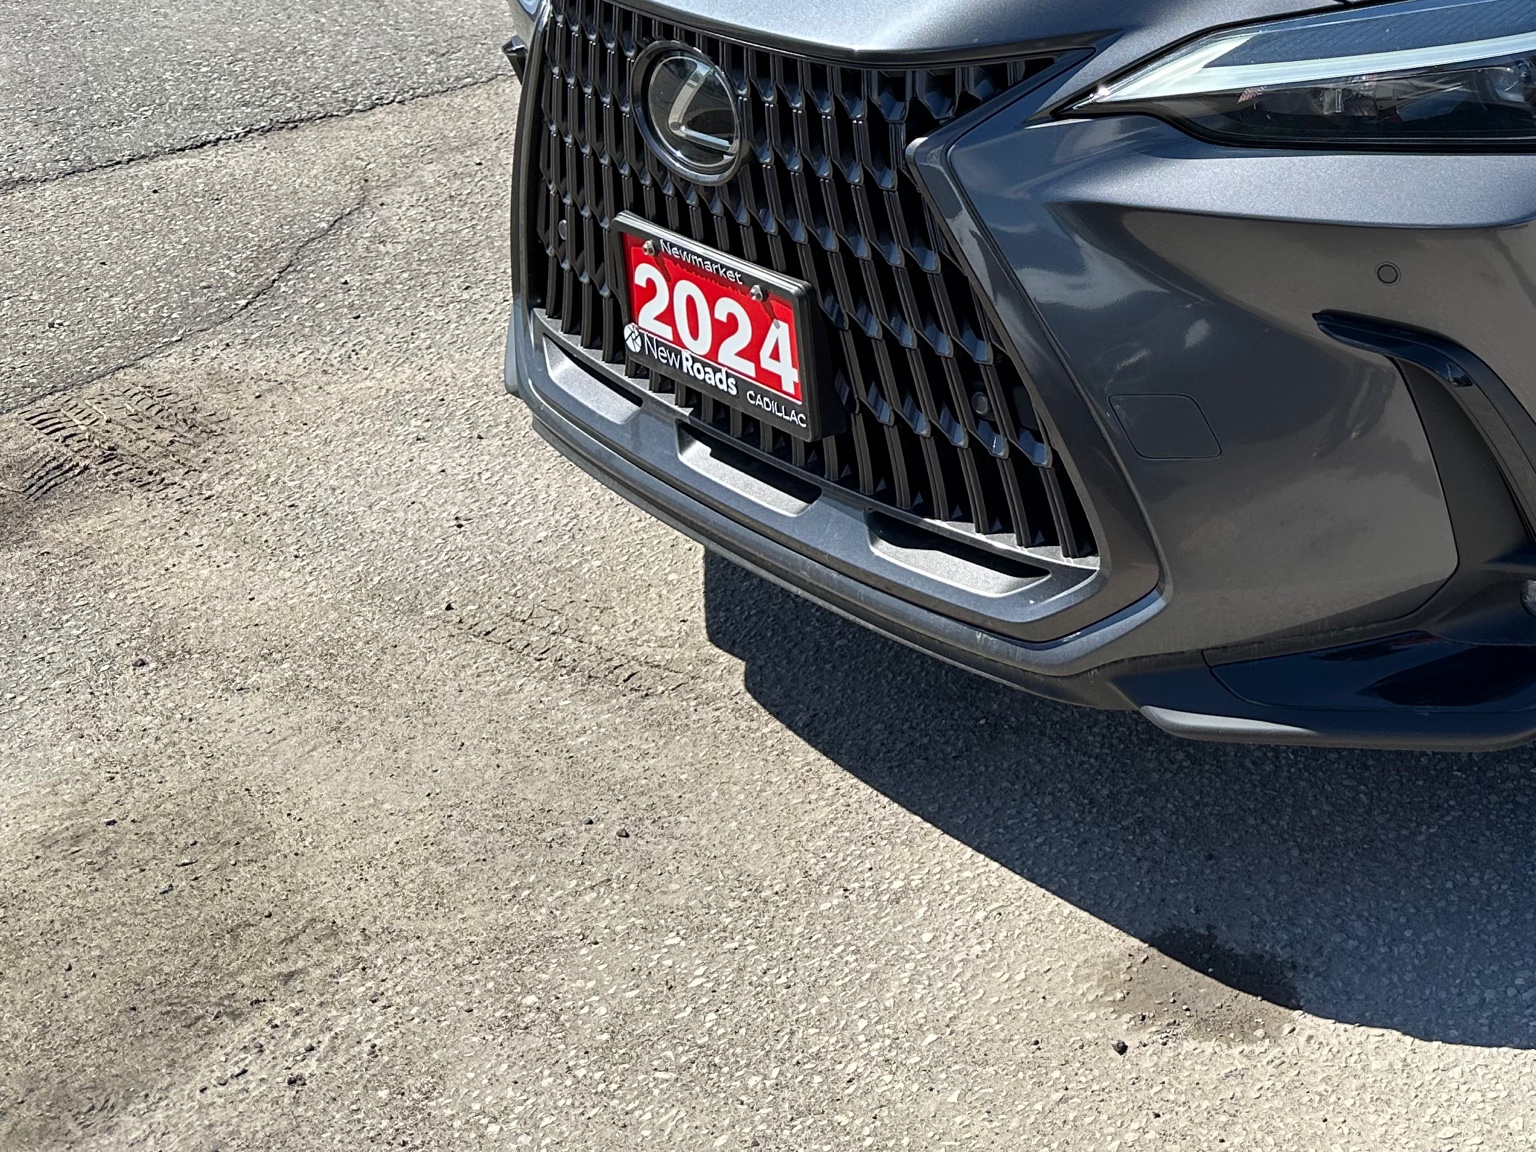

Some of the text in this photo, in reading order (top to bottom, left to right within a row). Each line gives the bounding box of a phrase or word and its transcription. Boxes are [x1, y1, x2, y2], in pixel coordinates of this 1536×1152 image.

[659, 238, 744, 286] Newmarket
[633, 262, 799, 395] 2024
[746, 390, 807, 428] CADILLAC
